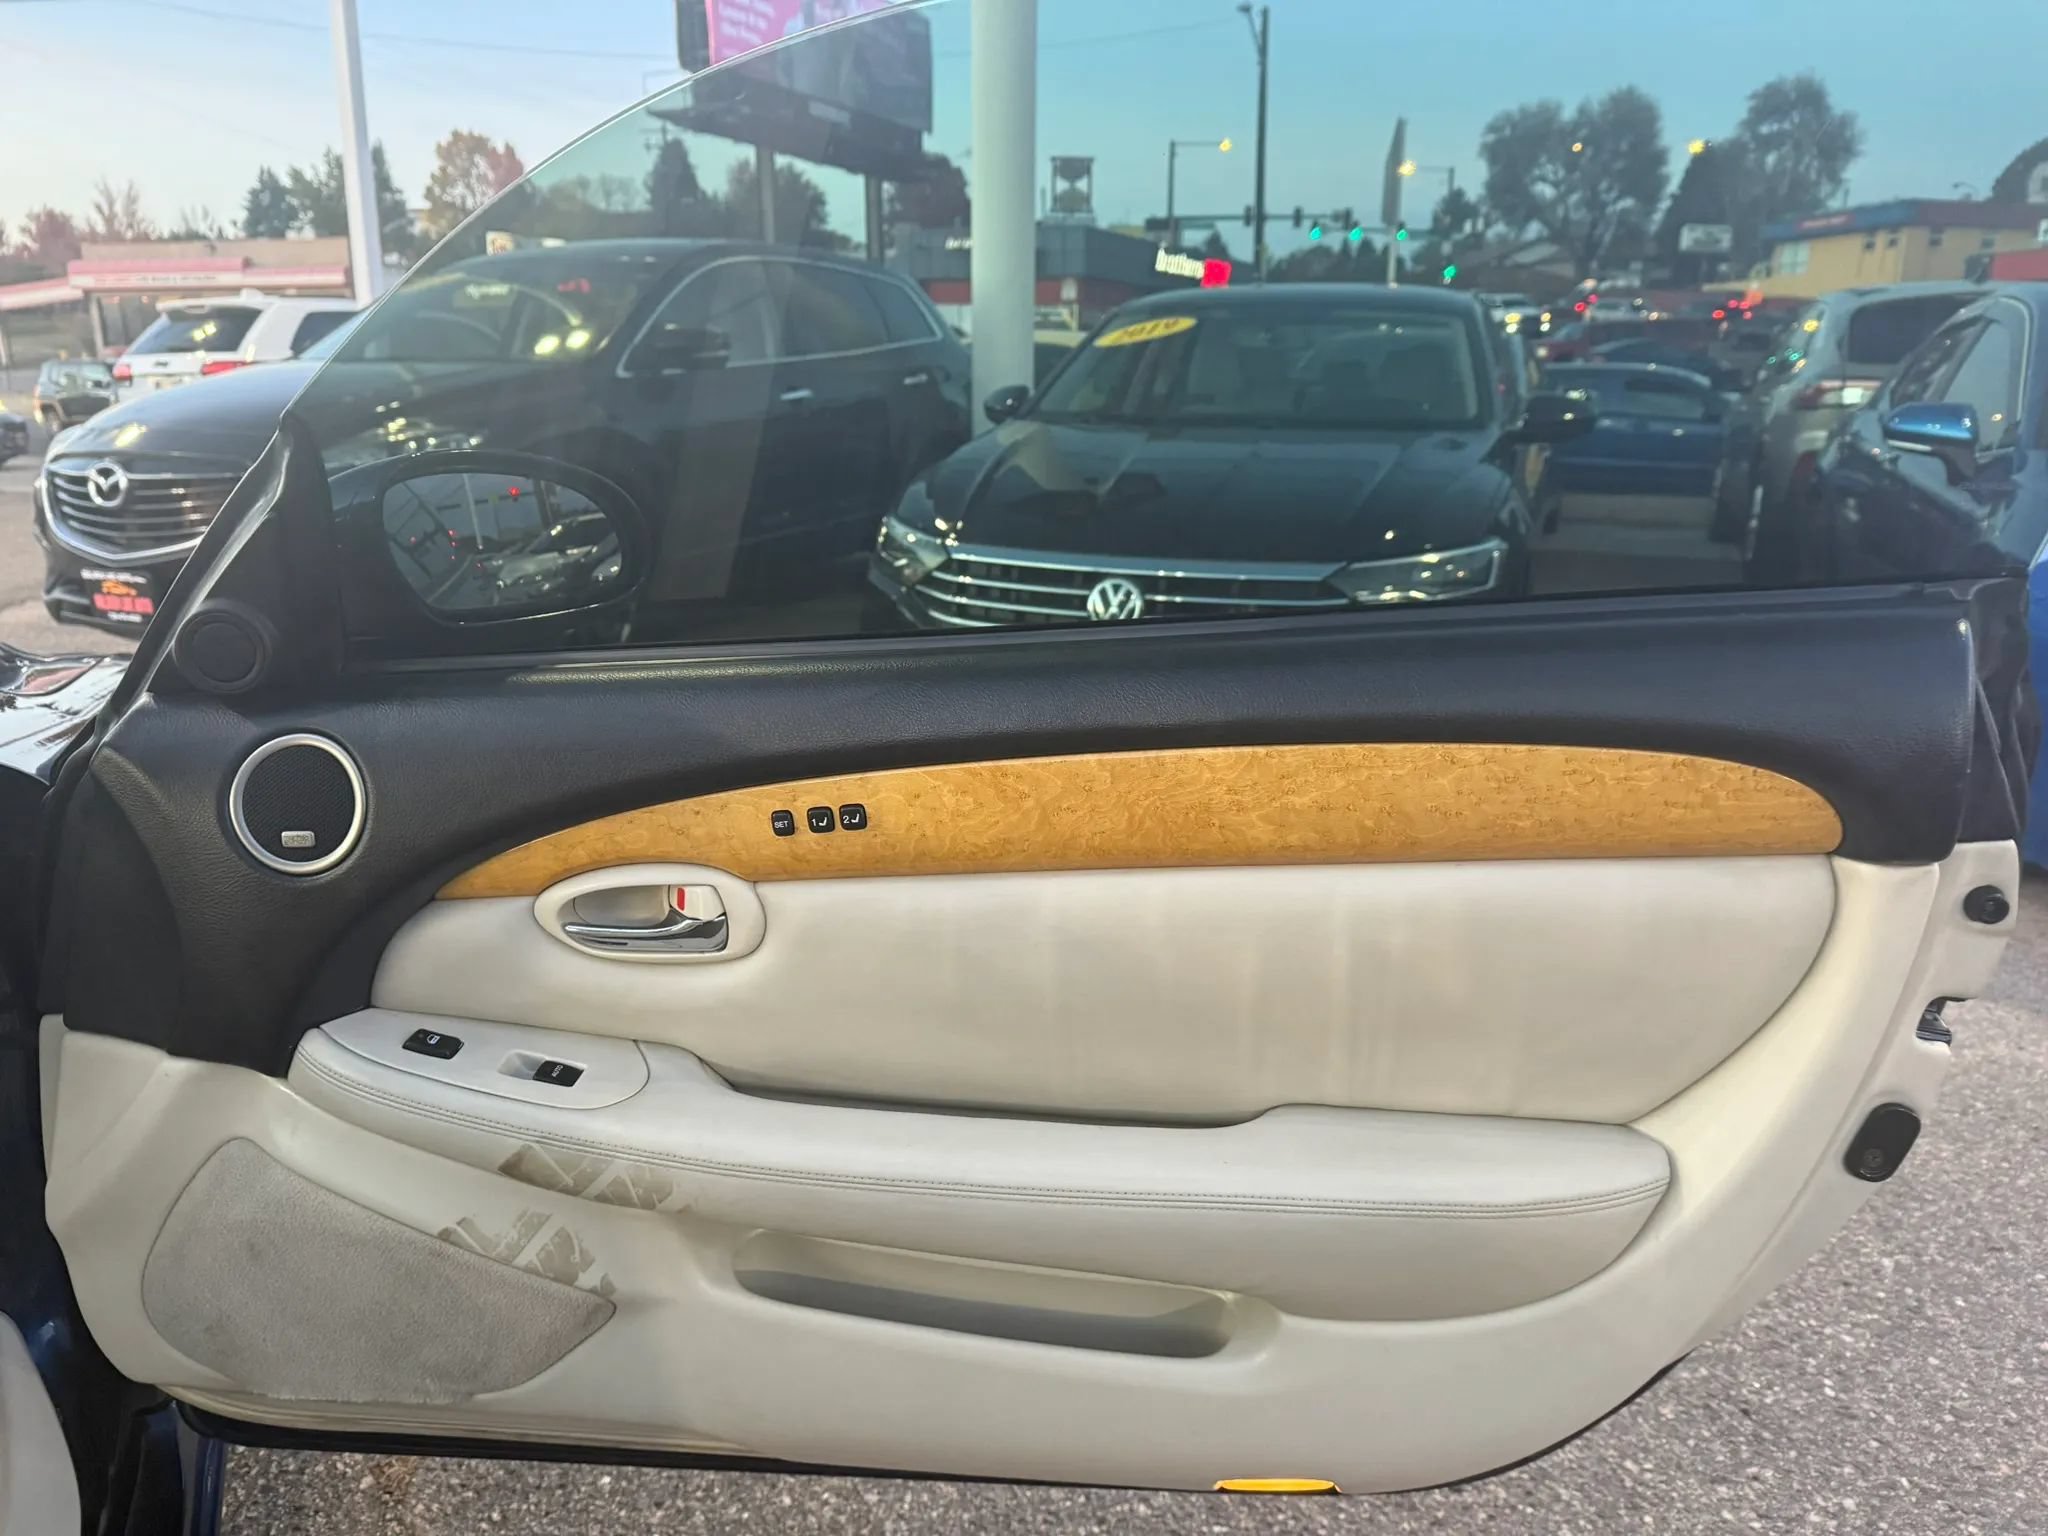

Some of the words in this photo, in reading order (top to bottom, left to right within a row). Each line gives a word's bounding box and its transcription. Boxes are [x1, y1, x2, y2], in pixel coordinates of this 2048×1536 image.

[842, 815, 850, 824] 2
[774, 820, 789, 829] SET
[551, 1064, 564, 1078] AUTO
